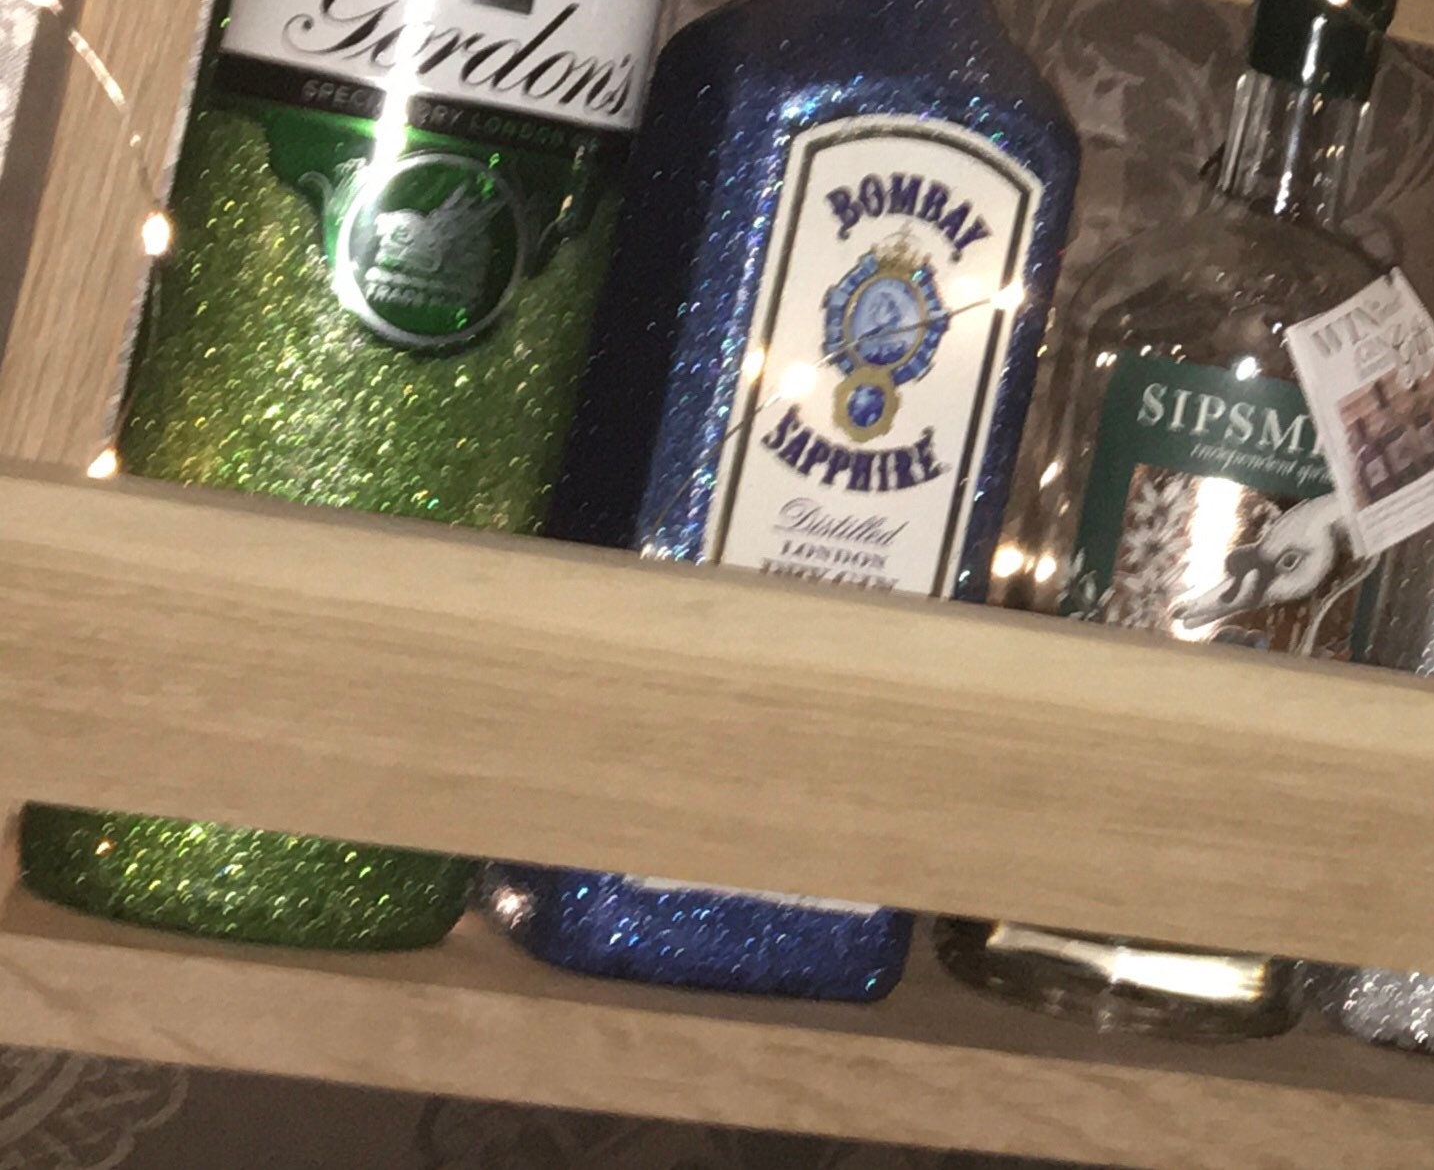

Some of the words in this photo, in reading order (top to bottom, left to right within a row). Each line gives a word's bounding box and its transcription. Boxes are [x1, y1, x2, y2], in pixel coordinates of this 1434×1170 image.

[825, 171, 993, 263] BOMBAY
[760, 404, 950, 494] SAPPHIRE
[773, 496, 912, 548] Distilled
[779, 538, 892, 571] LONDON
